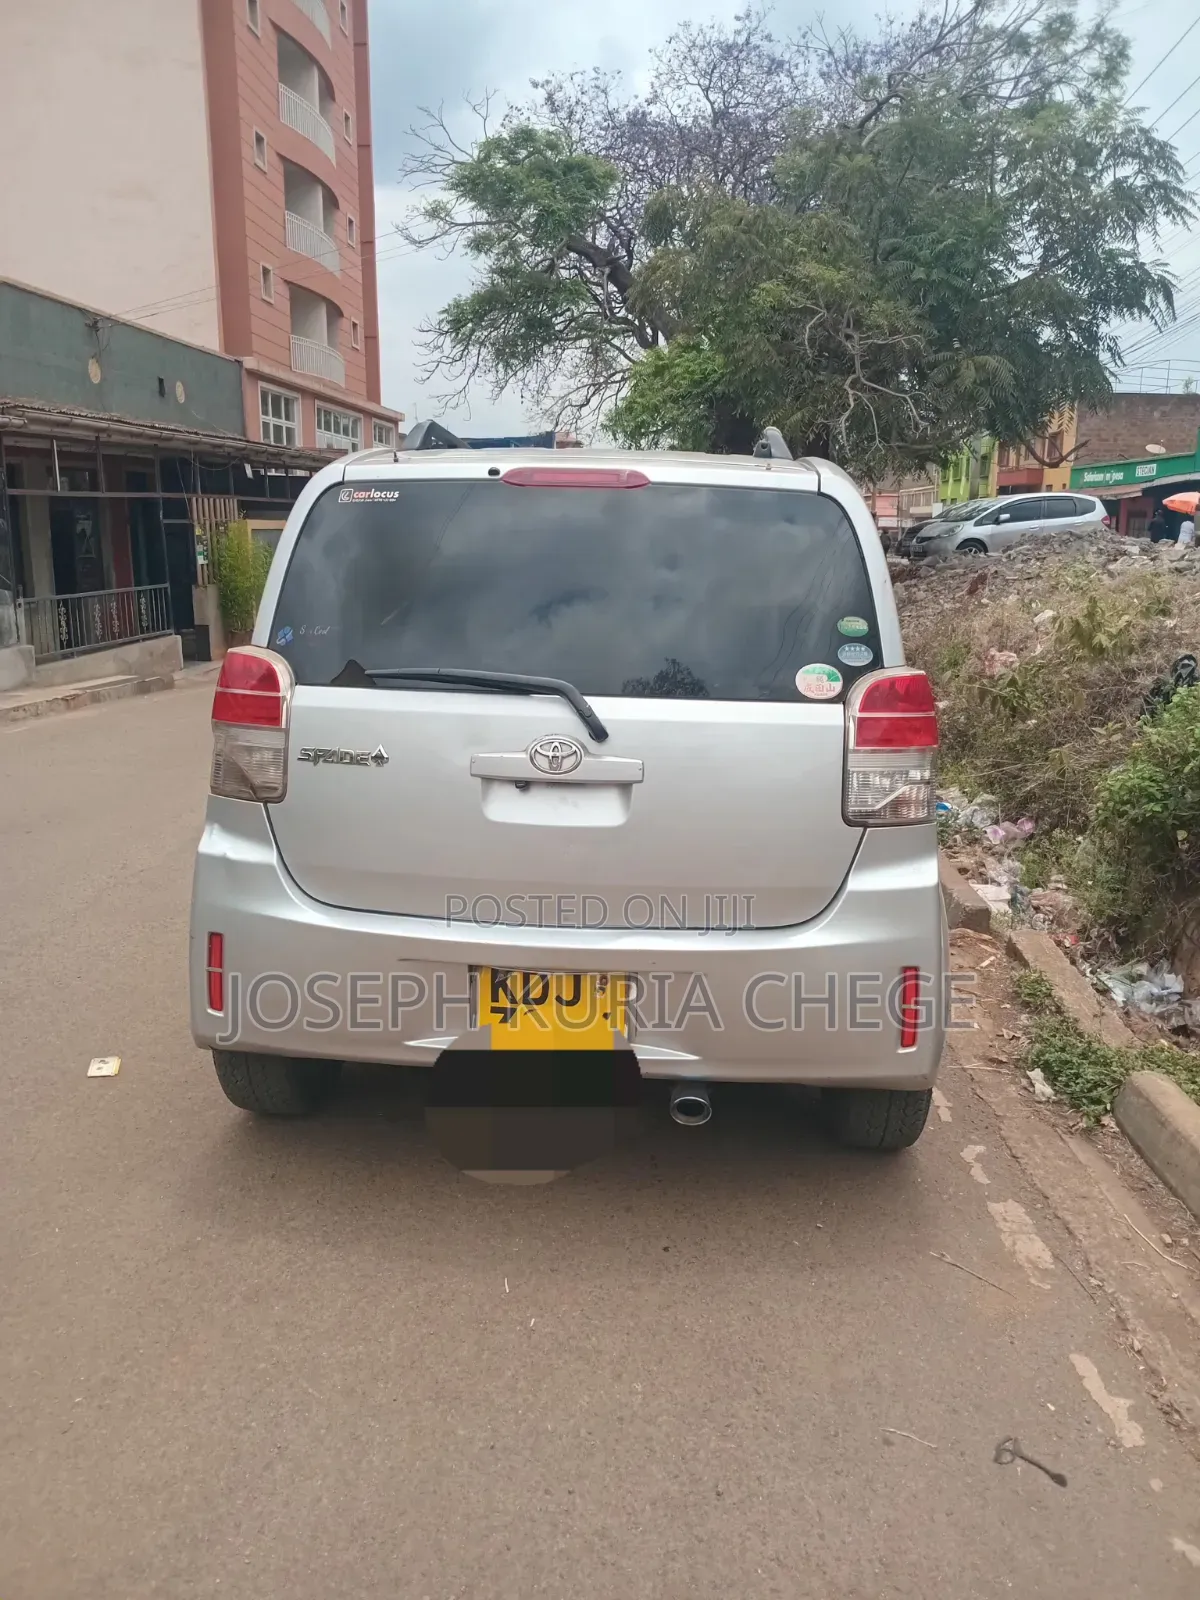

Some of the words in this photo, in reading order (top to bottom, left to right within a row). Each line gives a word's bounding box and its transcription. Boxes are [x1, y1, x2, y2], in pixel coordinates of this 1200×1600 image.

[353, 488, 400, 499] carlocus
[297, 746, 371, 767] SPADE
[490, 967, 582, 1007] KDJ
